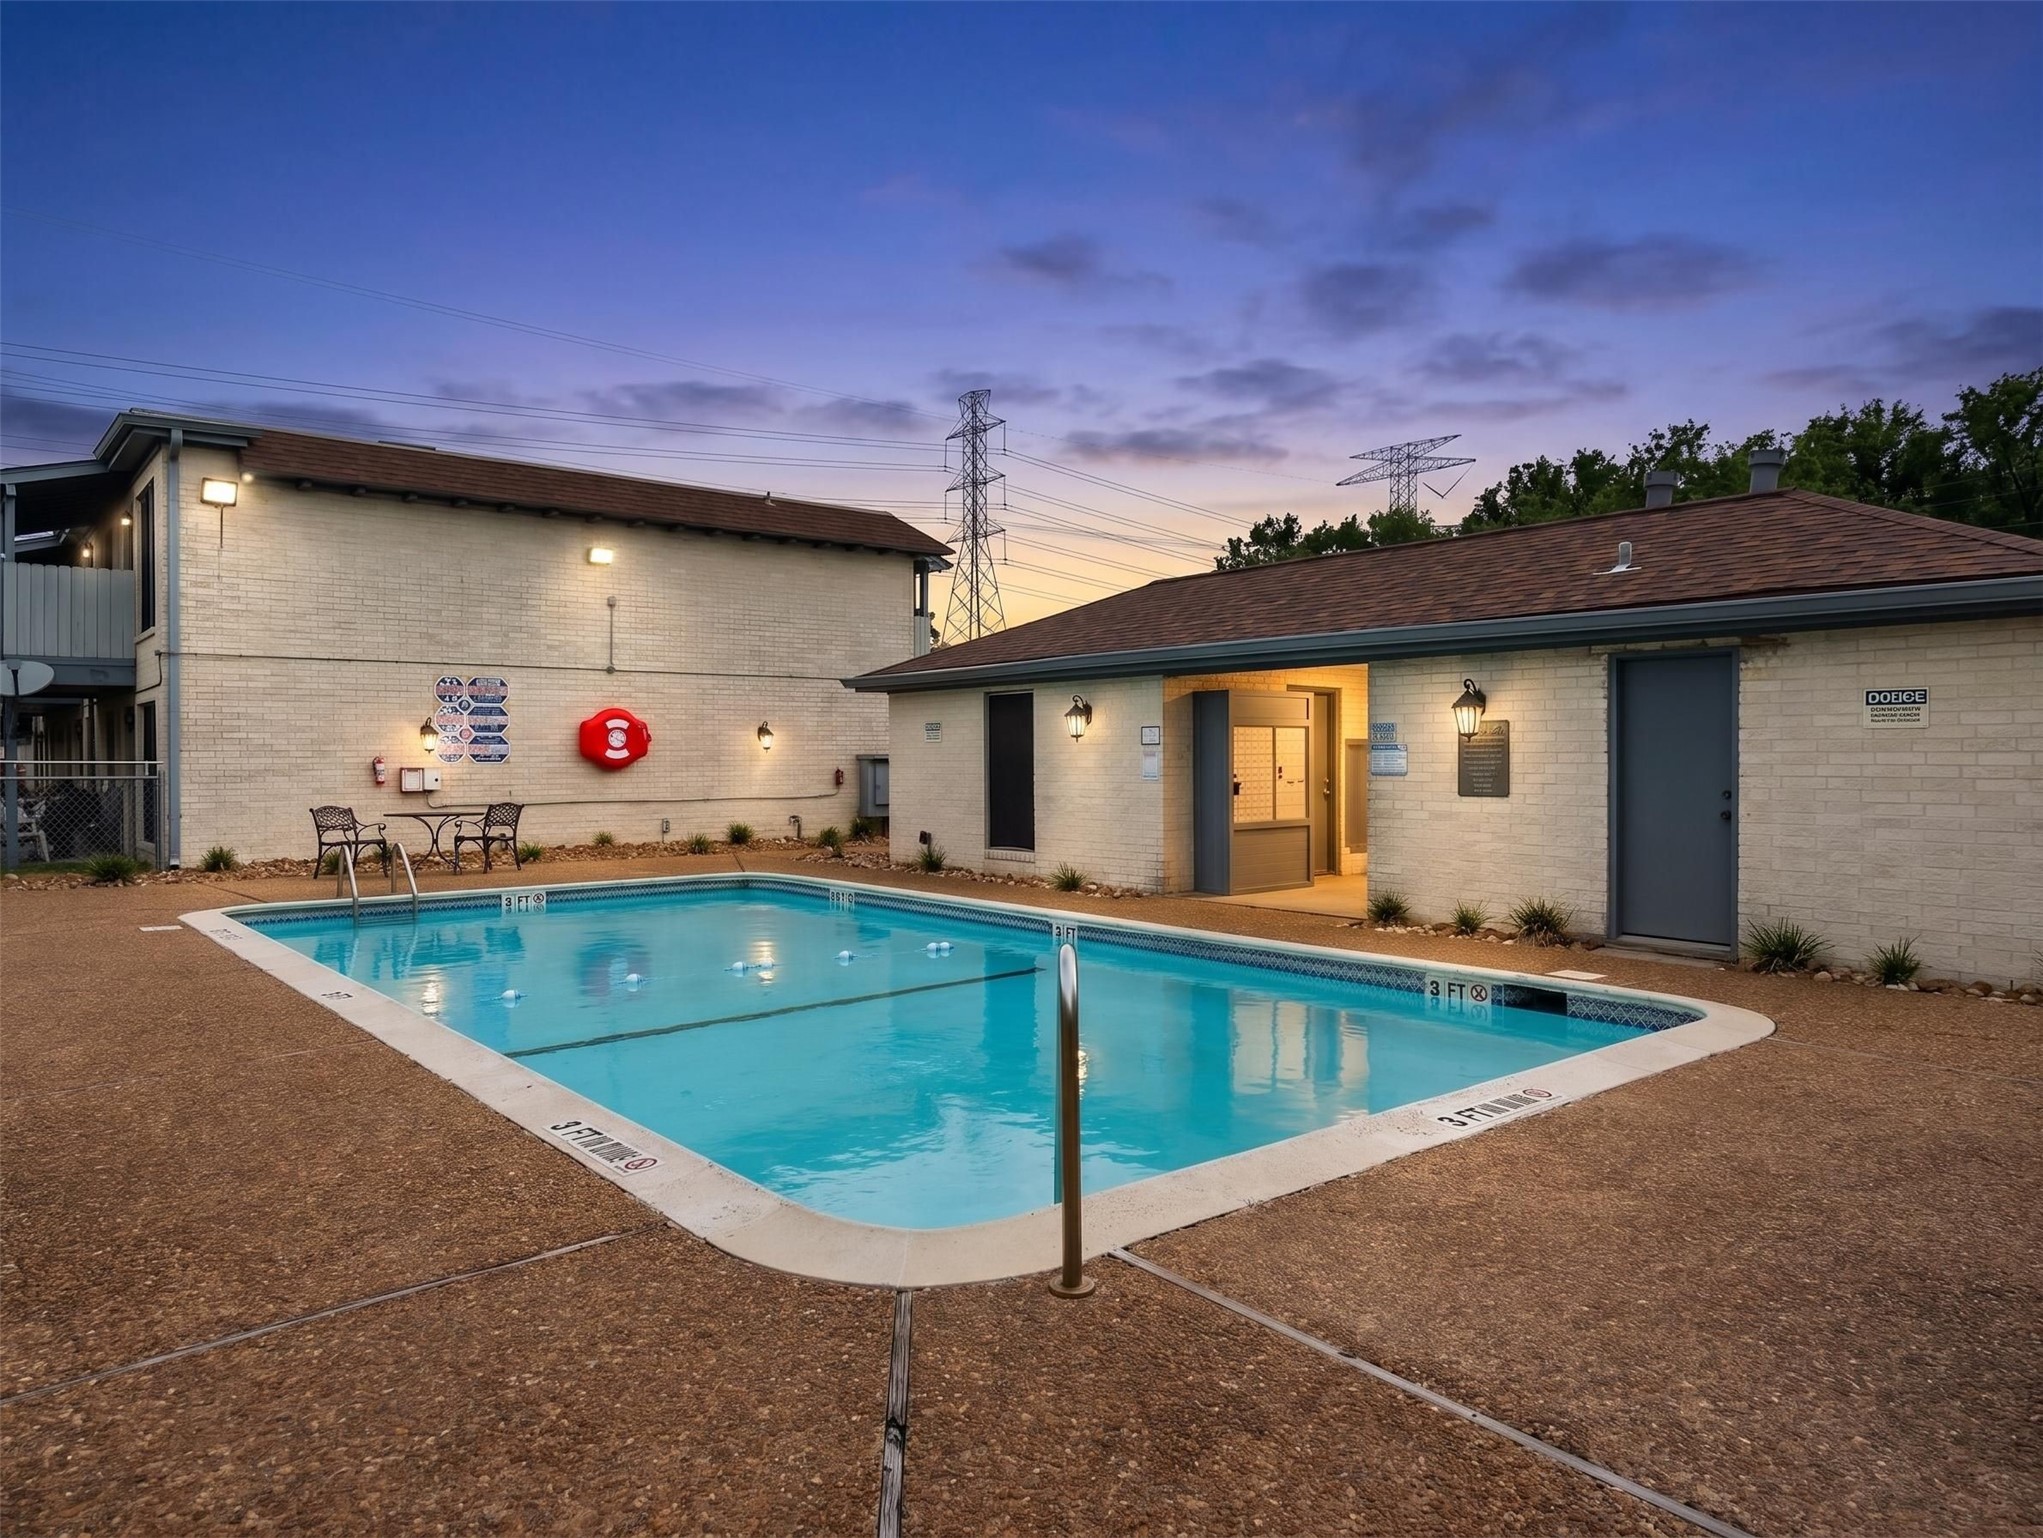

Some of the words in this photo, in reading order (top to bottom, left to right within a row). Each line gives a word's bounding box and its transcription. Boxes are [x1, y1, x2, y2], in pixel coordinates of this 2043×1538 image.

[505, 896, 512, 907] 3
[517, 895, 530, 906] FT
[1055, 926, 1061, 937] 3
[1066, 927, 1076, 939] FT
[1430, 980, 1440, 996] 3
[1448, 982, 1466, 1000] FT
[1437, 1116, 1469, 1127] 3
[1453, 1107, 1494, 1122] FT
[550, 1120, 582, 1131] 3
[561, 1127, 604, 1141] FT
